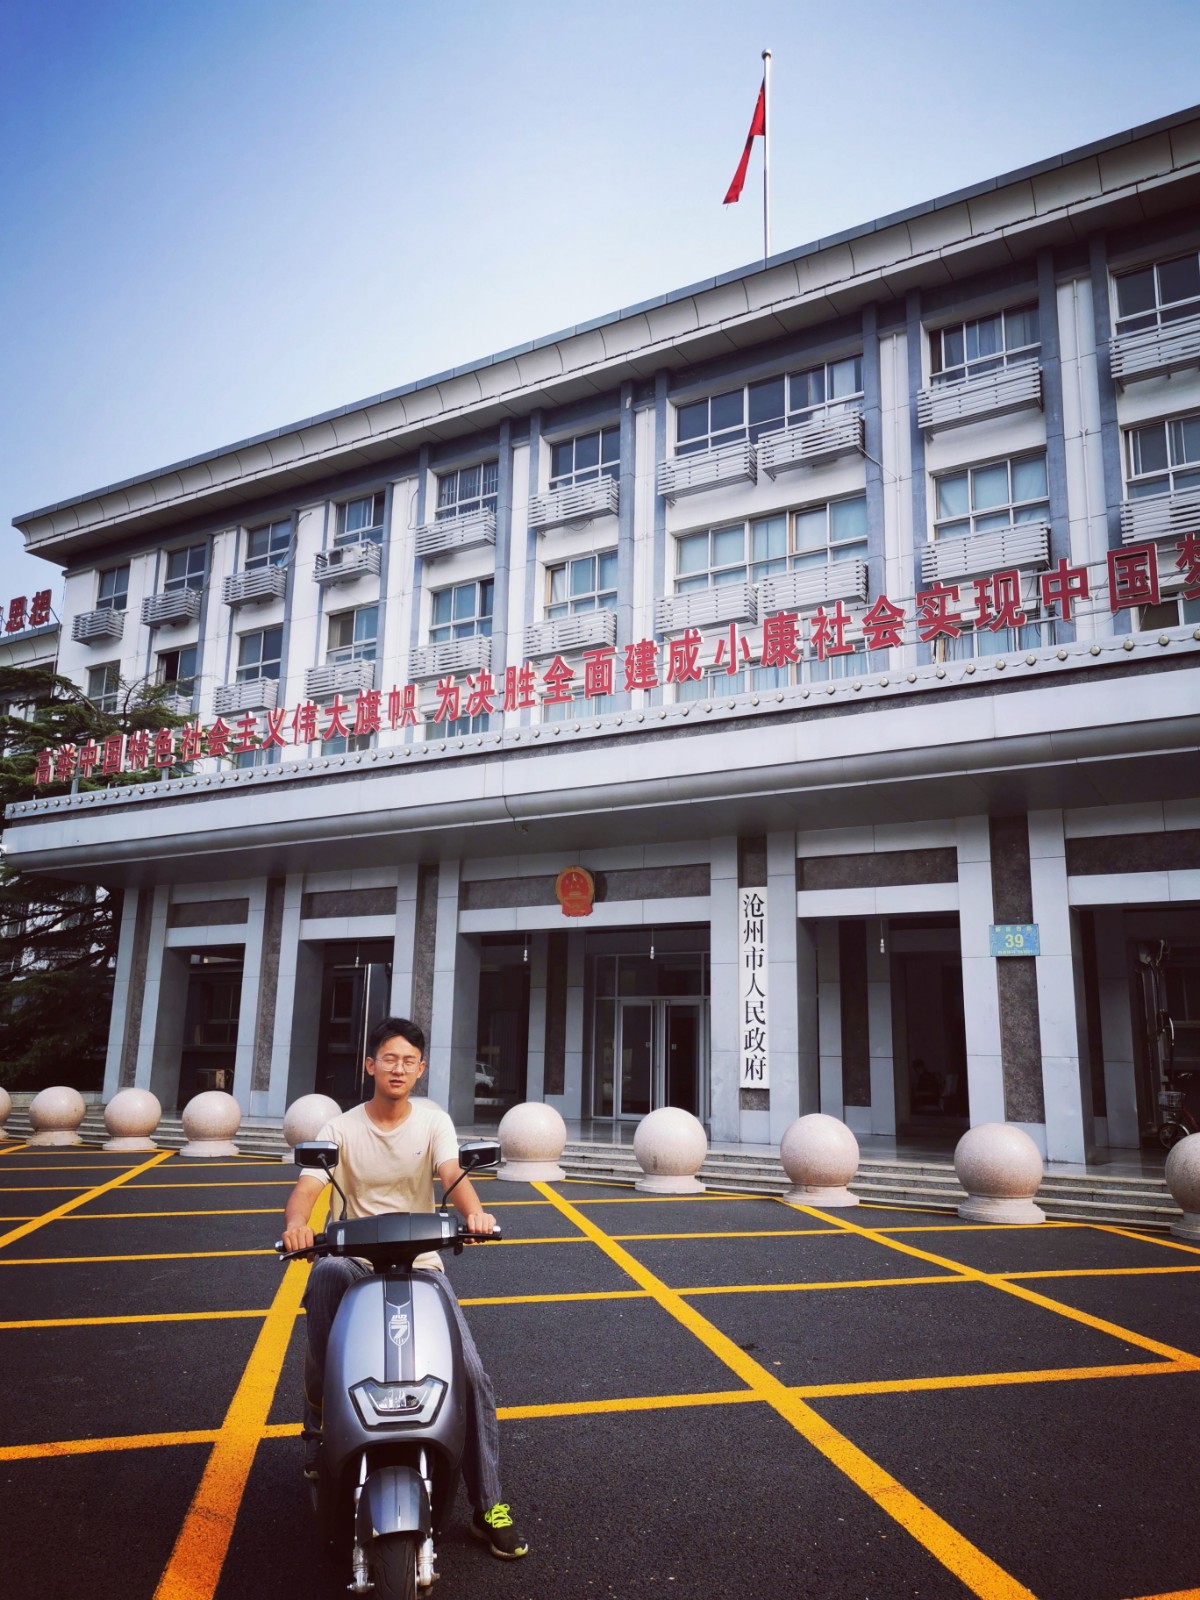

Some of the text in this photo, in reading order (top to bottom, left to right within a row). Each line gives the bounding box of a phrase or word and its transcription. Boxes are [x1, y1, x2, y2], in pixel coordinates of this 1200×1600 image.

[0, 589, 52, 633] 思想
[34, 683, 420, 786] 高举中国特色社会主义伟大旗帜
[1005, 933, 1024, 948] 39
[743, 893, 767, 1081] 沧州市人民政府
